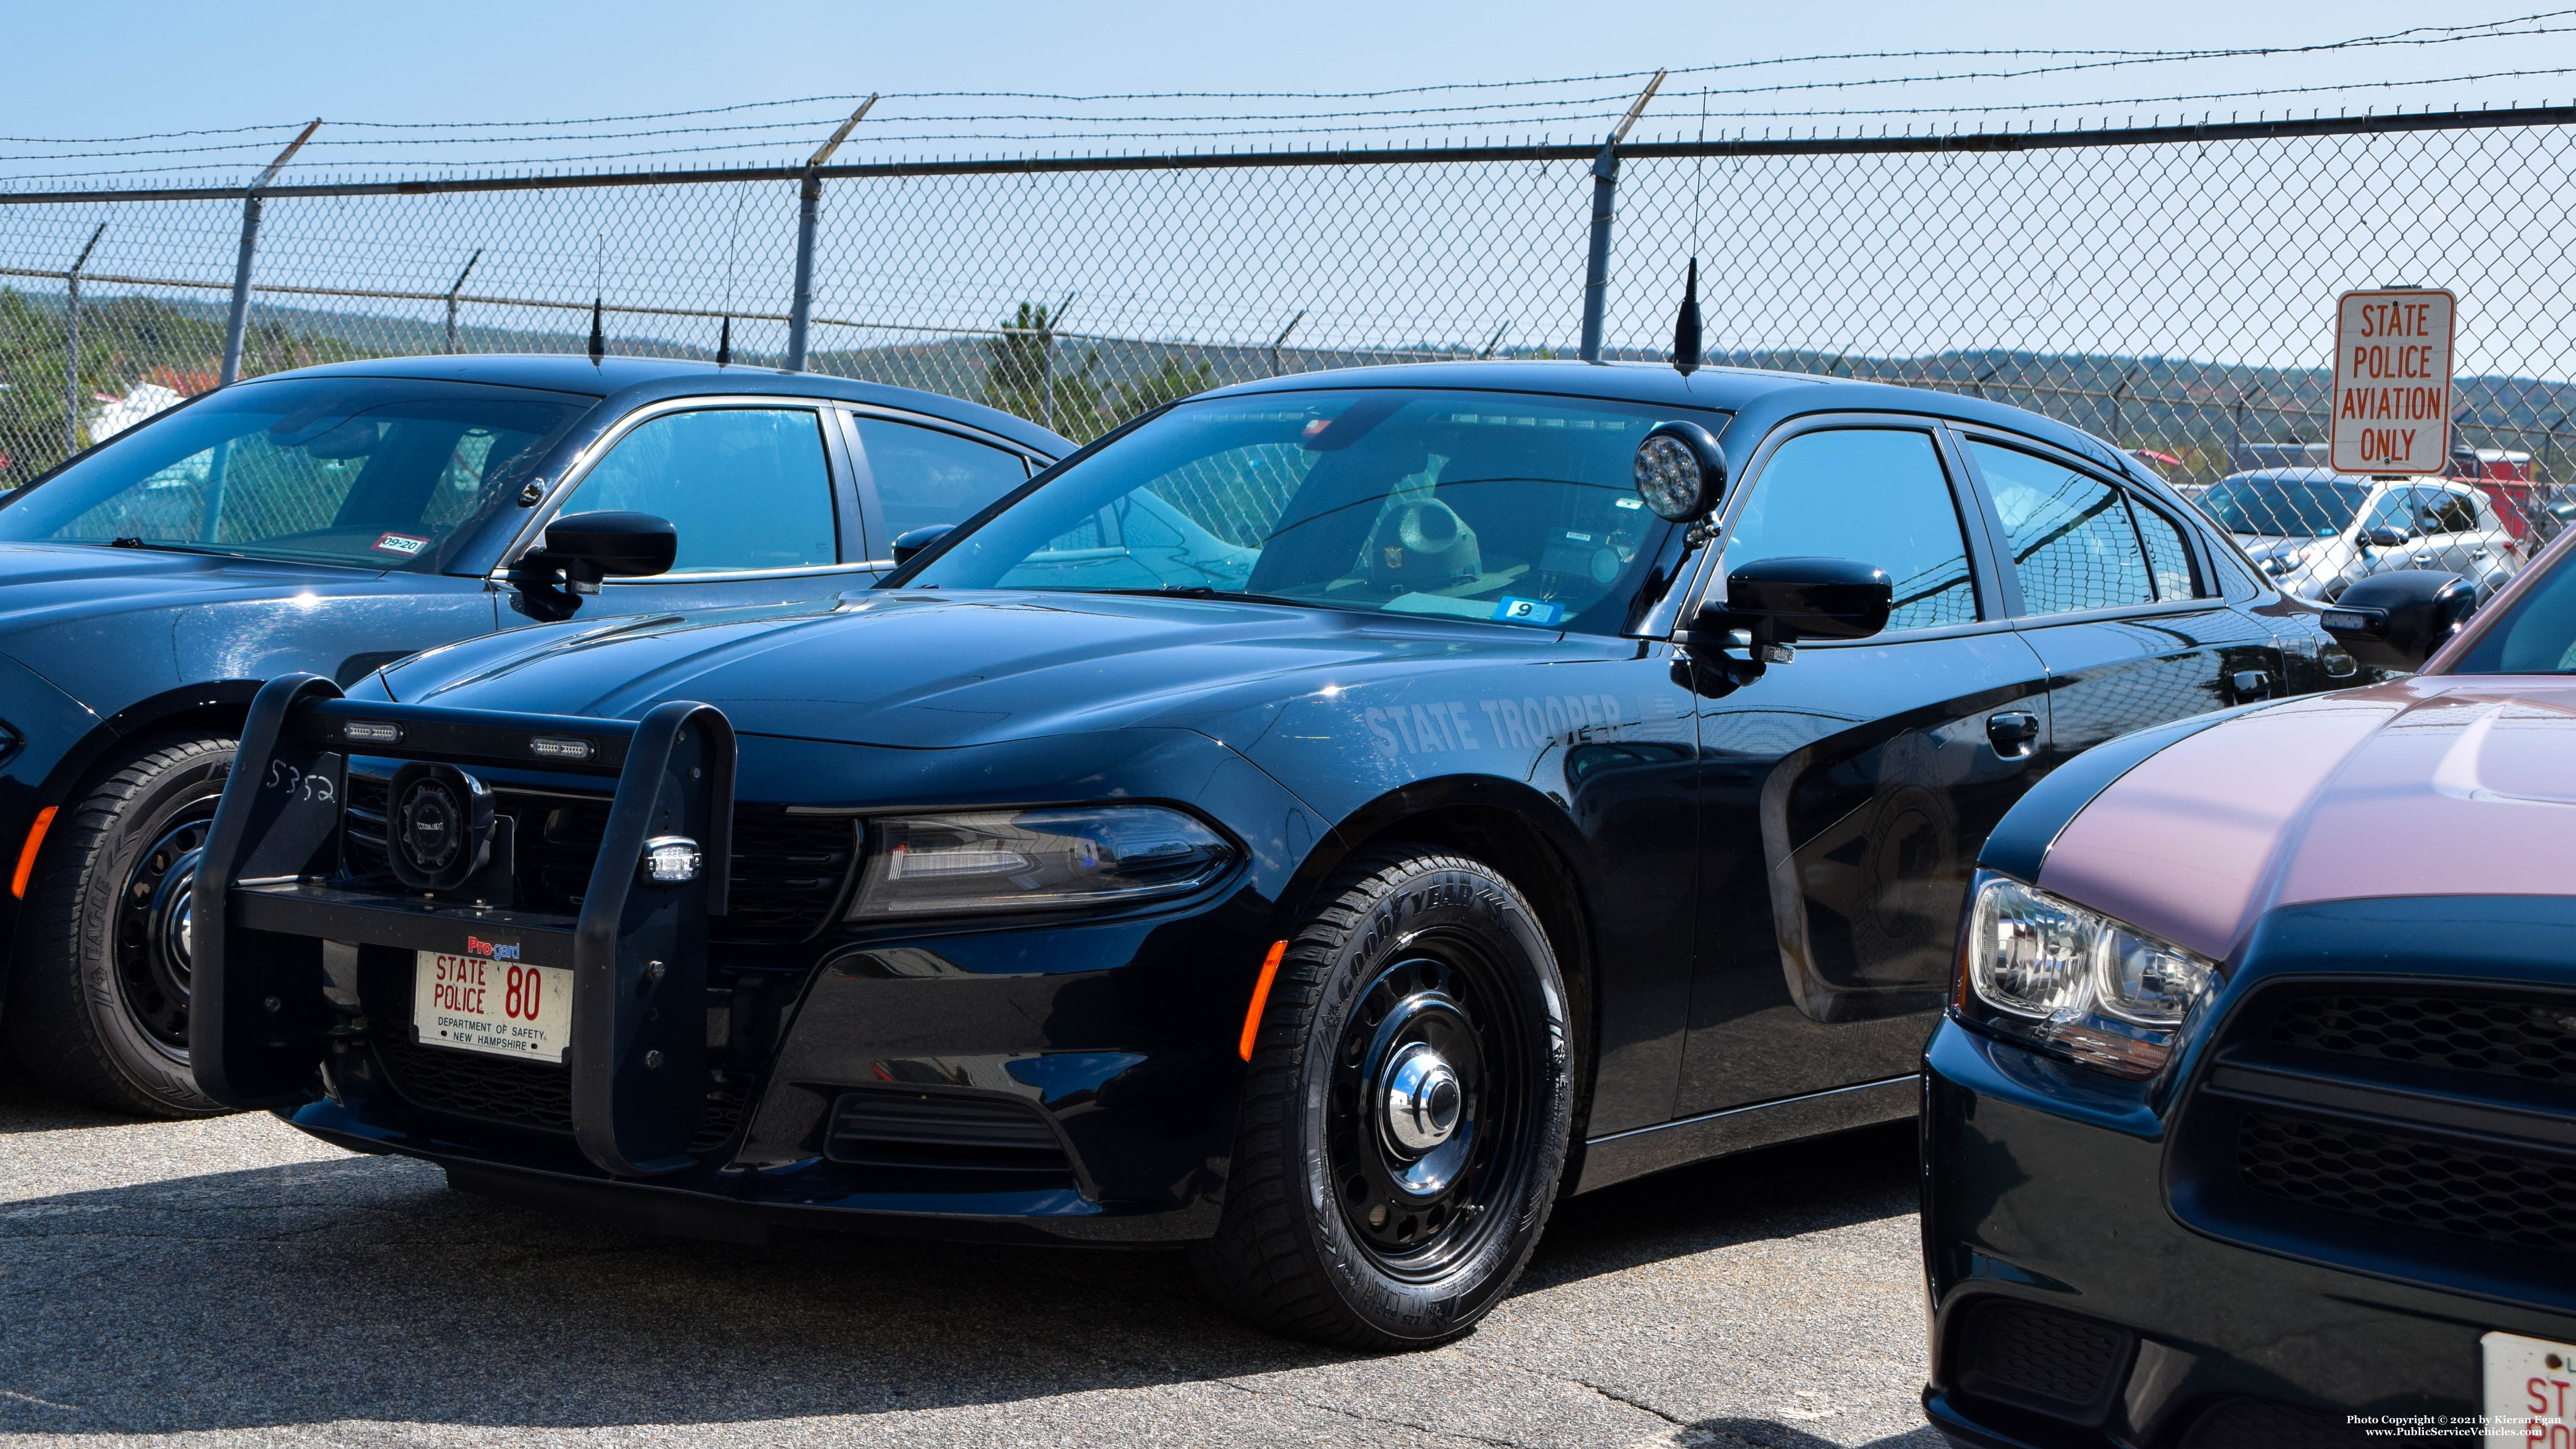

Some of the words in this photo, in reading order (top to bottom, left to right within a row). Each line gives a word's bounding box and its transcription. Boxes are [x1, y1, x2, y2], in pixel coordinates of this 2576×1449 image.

[2361, 304, 2430, 337] STATE
[2353, 345, 2432, 379] POLICE
[2341, 387, 2441, 420] AVIATION
[2361, 428, 2416, 461] ONLY
[383, 537, 418, 549] 09-20
[1516, 603, 1533, 617] 9
[1365, 701, 1480, 758] STATE
[1478, 694, 1629, 749] TROOPER
[266, 759, 336, 803] 5352
[468, 936, 519, 961] Pro-gard
[436, 956, 487, 986] STATE
[434, 983, 486, 1014] POLICE
[505, 966, 541, 1020] 80
[438, 1017, 492, 1032] DEPARTMENT
[496, 1024, 507, 1034] OF
[512, 1027, 545, 1040] SAFETY
[454, 1031, 472, 1043] NEW
[478, 1035, 527, 1050] HAMPSHIRE
[2527, 1377, 2576, 1420] ST
[2527, 1419, 2576, 1449] PO
